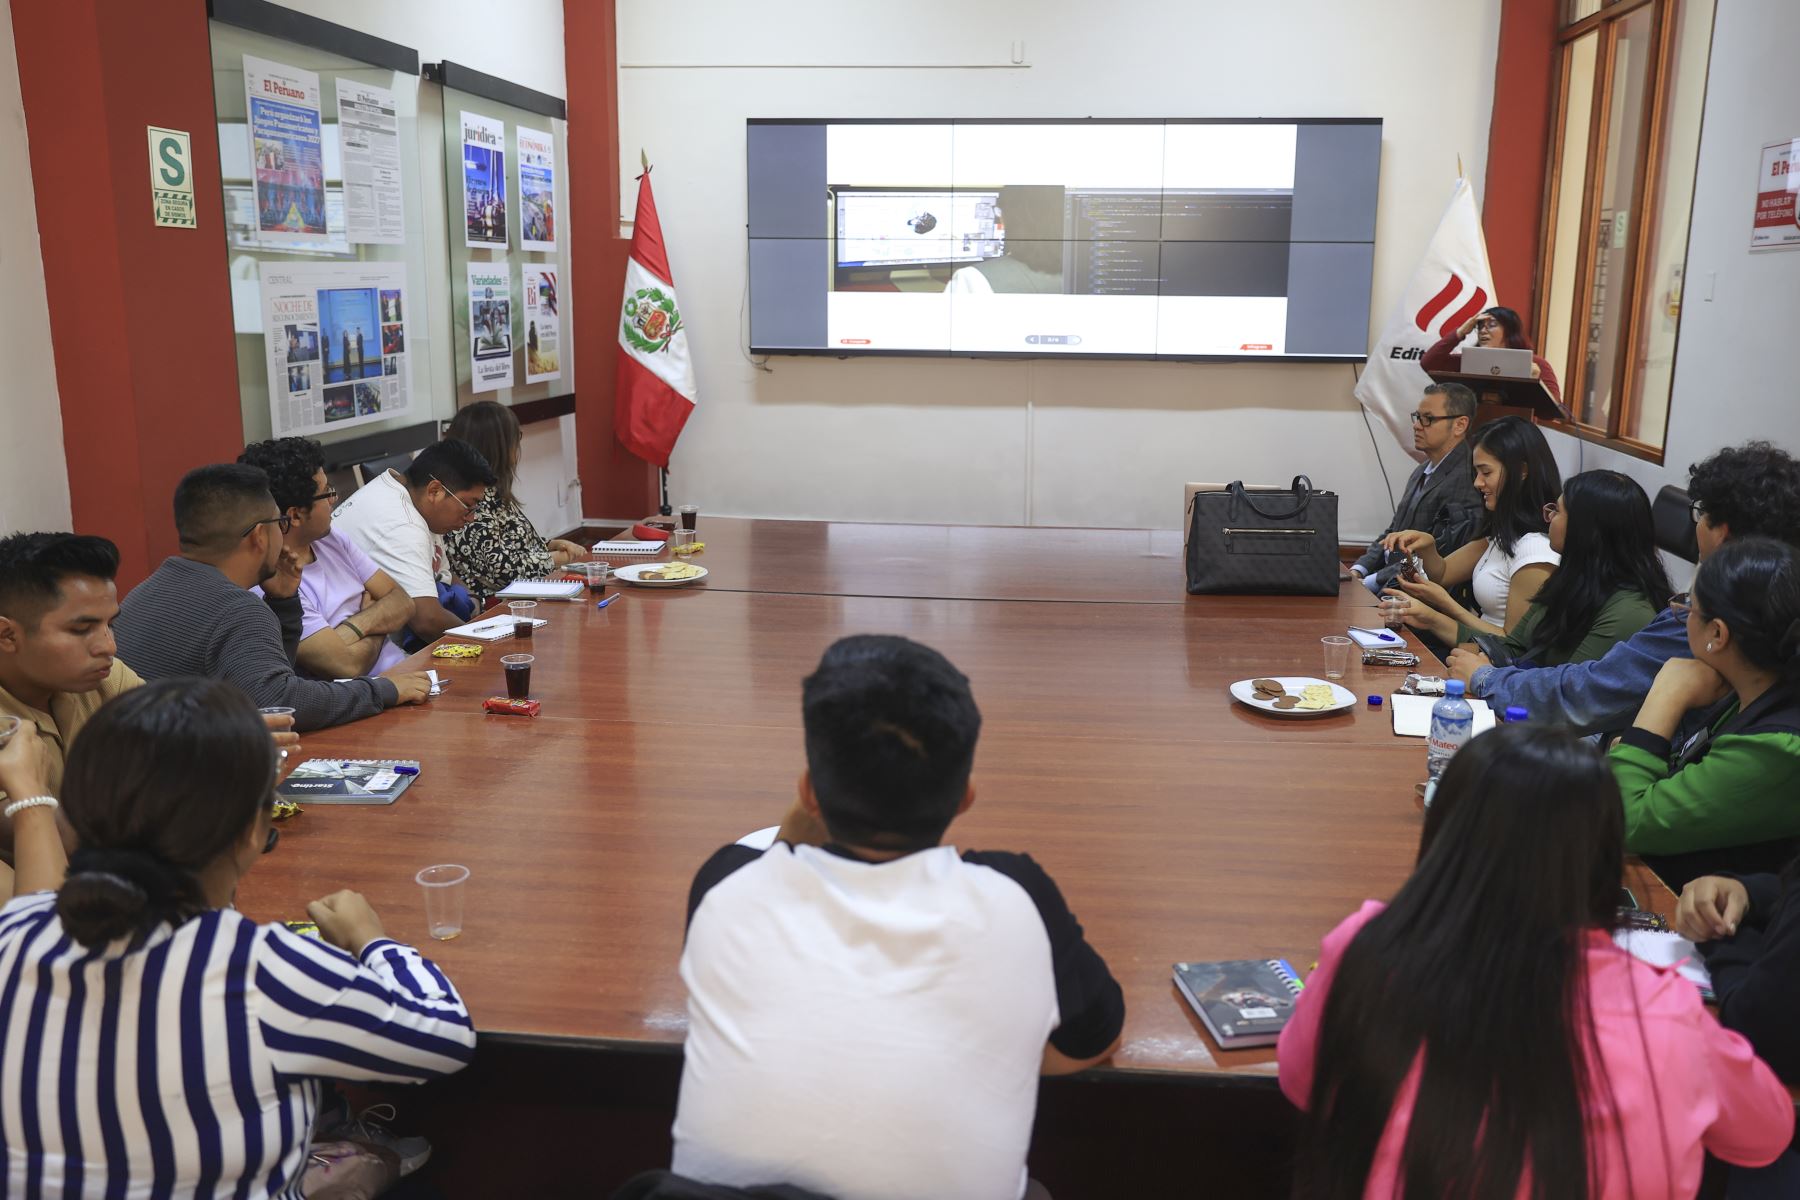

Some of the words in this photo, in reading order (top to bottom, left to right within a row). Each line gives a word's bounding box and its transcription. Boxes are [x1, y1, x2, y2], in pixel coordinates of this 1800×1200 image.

[264, 79, 272, 92] El
[273, 82, 305, 99] Peruano
[159, 137, 185, 186] S
[1771, 161, 1780, 176] El
[471, 274, 502, 286] Variedades
[273, 300, 303, 313] NOCHE
[1432, 738, 1458, 750] Mateo
